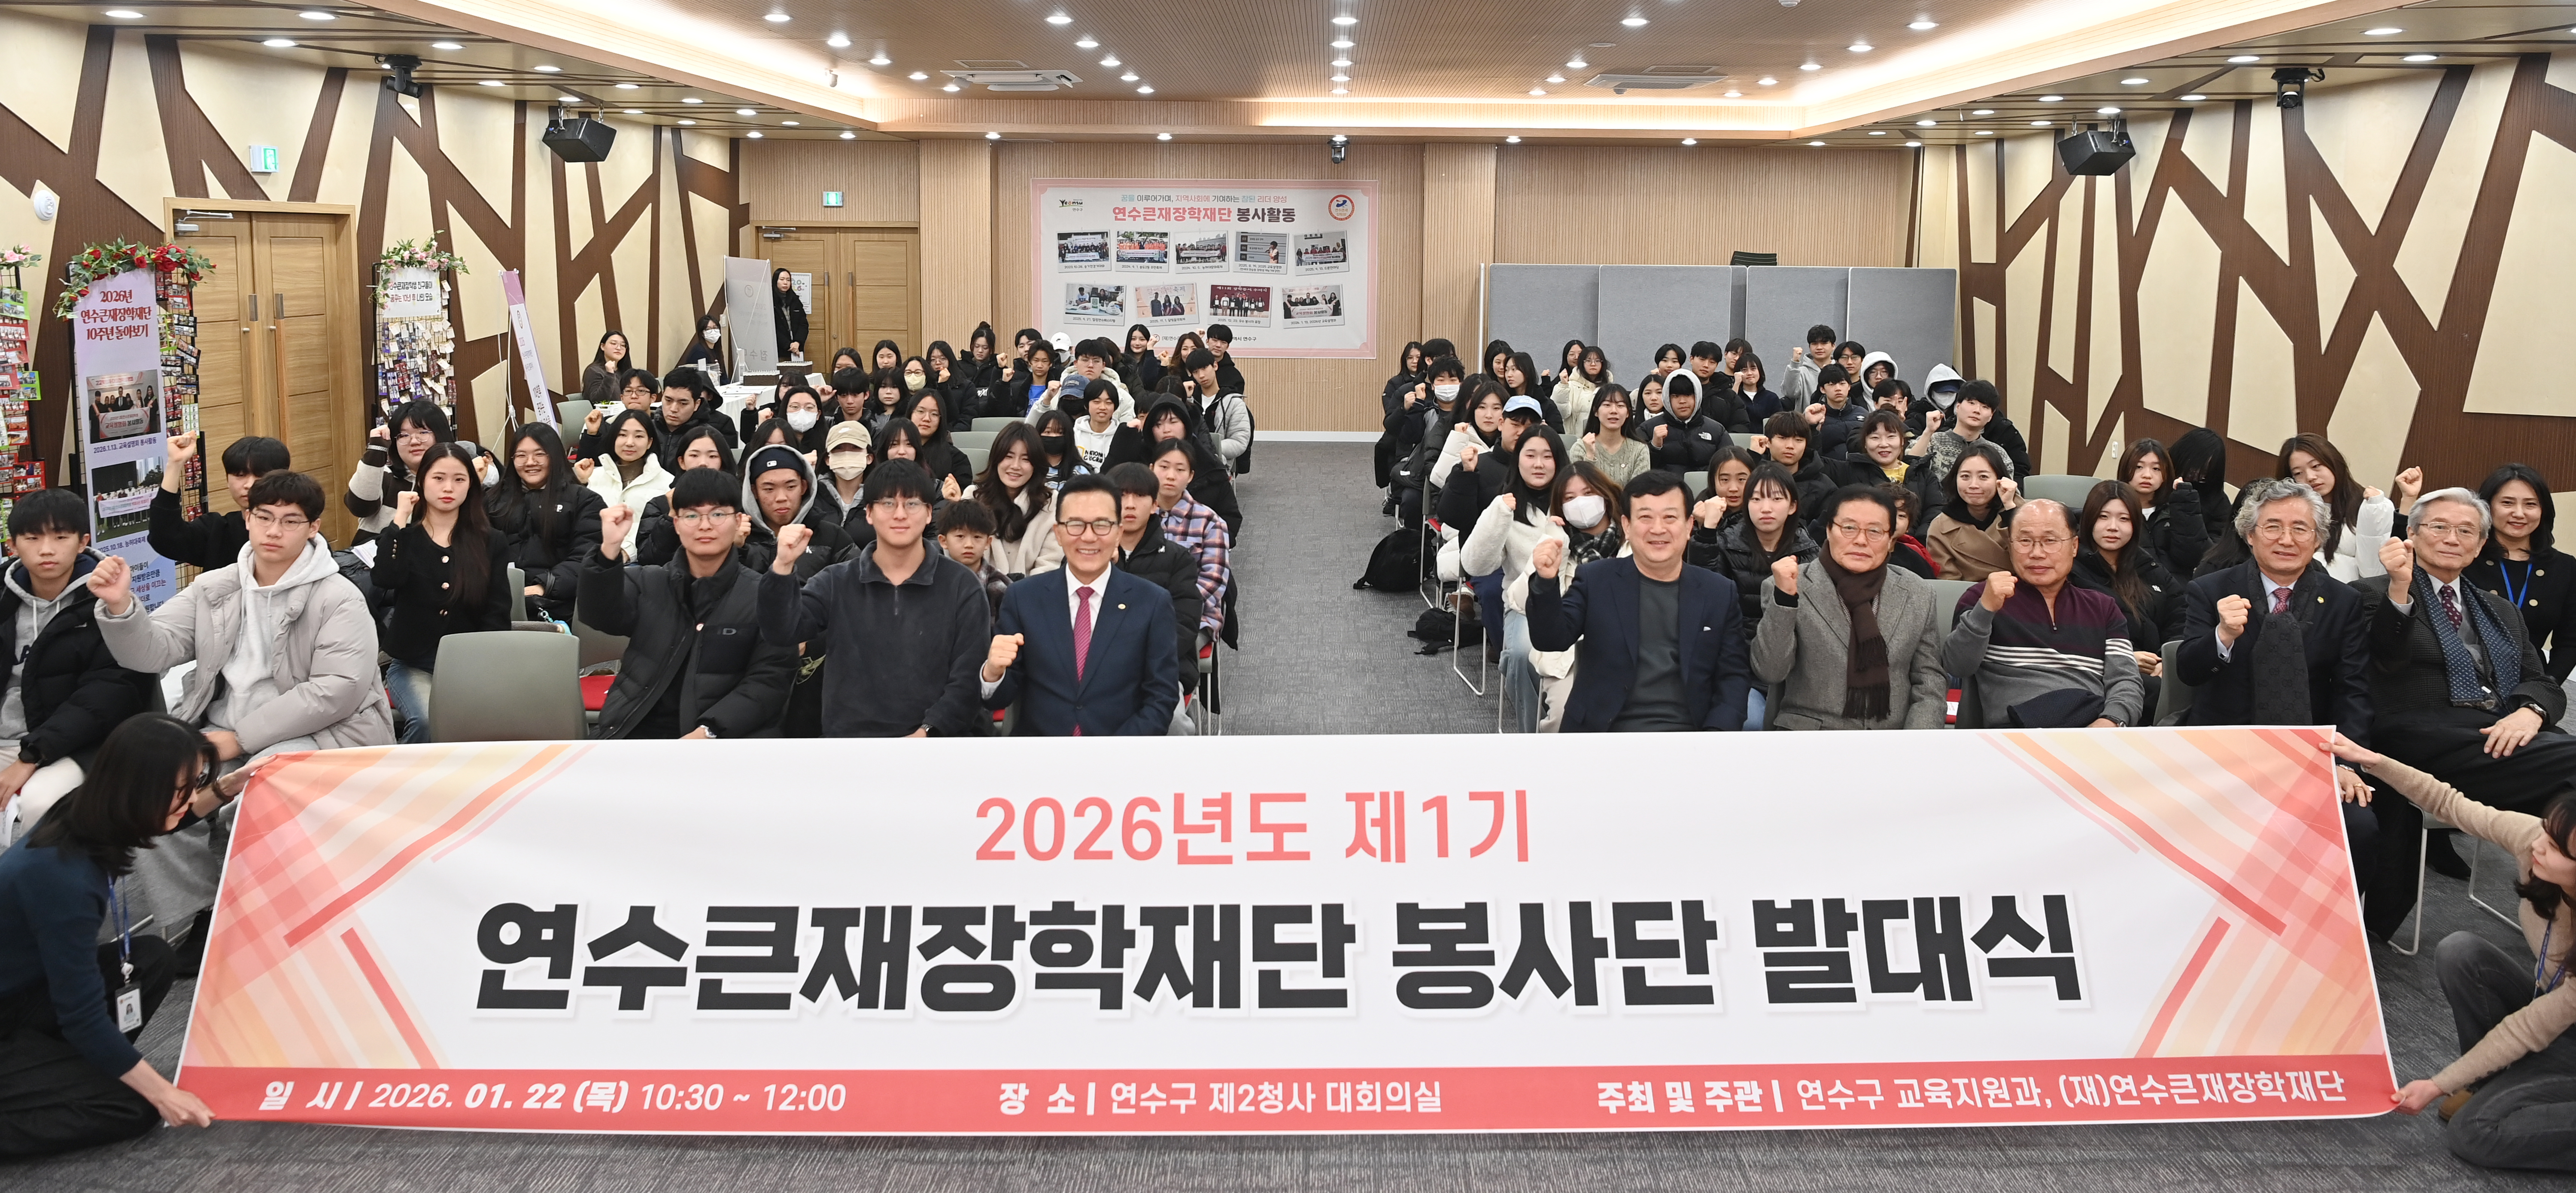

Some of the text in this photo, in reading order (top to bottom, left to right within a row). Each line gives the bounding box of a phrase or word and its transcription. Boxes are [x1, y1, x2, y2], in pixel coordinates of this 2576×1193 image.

[1112, 207, 1296, 222] 연수큰재장학재단 봉사활동
[418, 281, 432, 289] 친구들이
[100, 289, 133, 303] 2026년
[425, 293, 433, 301] 모습
[80, 306, 152, 324] 연수큰재장학재단
[86, 323, 148, 341] 10주년 돌아보기
[118, 440, 139, 449] 교육설명회
[140, 437, 157, 446] 봉사활동
[125, 536, 146, 548] 능허대축제
[131, 569, 160, 583] 지원받은만큼
[136, 582, 151, 593] 세상을
[151, 579, 166, 588] 이끄는
[976, 790, 1529, 864] 2026년도 제1기
[476, 895, 2081, 1011] 연수큰재장학재단 봉사단 발대식
[259, 1081, 294, 1110] 일
[306, 1082, 342, 1109] 시
[368, 1083, 452, 1107] 2026.
[465, 1083, 512, 1108] 01.
[522, 1083, 565, 1108] 22
[573, 1080, 629, 1113] (목)
[642, 1083, 723, 1110] 10:30
[764, 1084, 846, 1111] 12:00
[999, 1083, 1029, 1114] 장
[1047, 1083, 1075, 1113] 소
[1111, 1083, 1196, 1114] 연수구
[1209, 1081, 1315, 1113] 제2청사
[1326, 1081, 1441, 1112] 대회의실
[1598, 1081, 1655, 1113] 주최
[1665, 1081, 1695, 1112] 및
[1704, 1080, 1762, 1112] 주관
[1797, 1079, 1884, 1110] 연수구
[1894, 1077, 2051, 1108] 교육지원과,
[2059, 1070, 2347, 1109] (재)연수큰재장학재단
